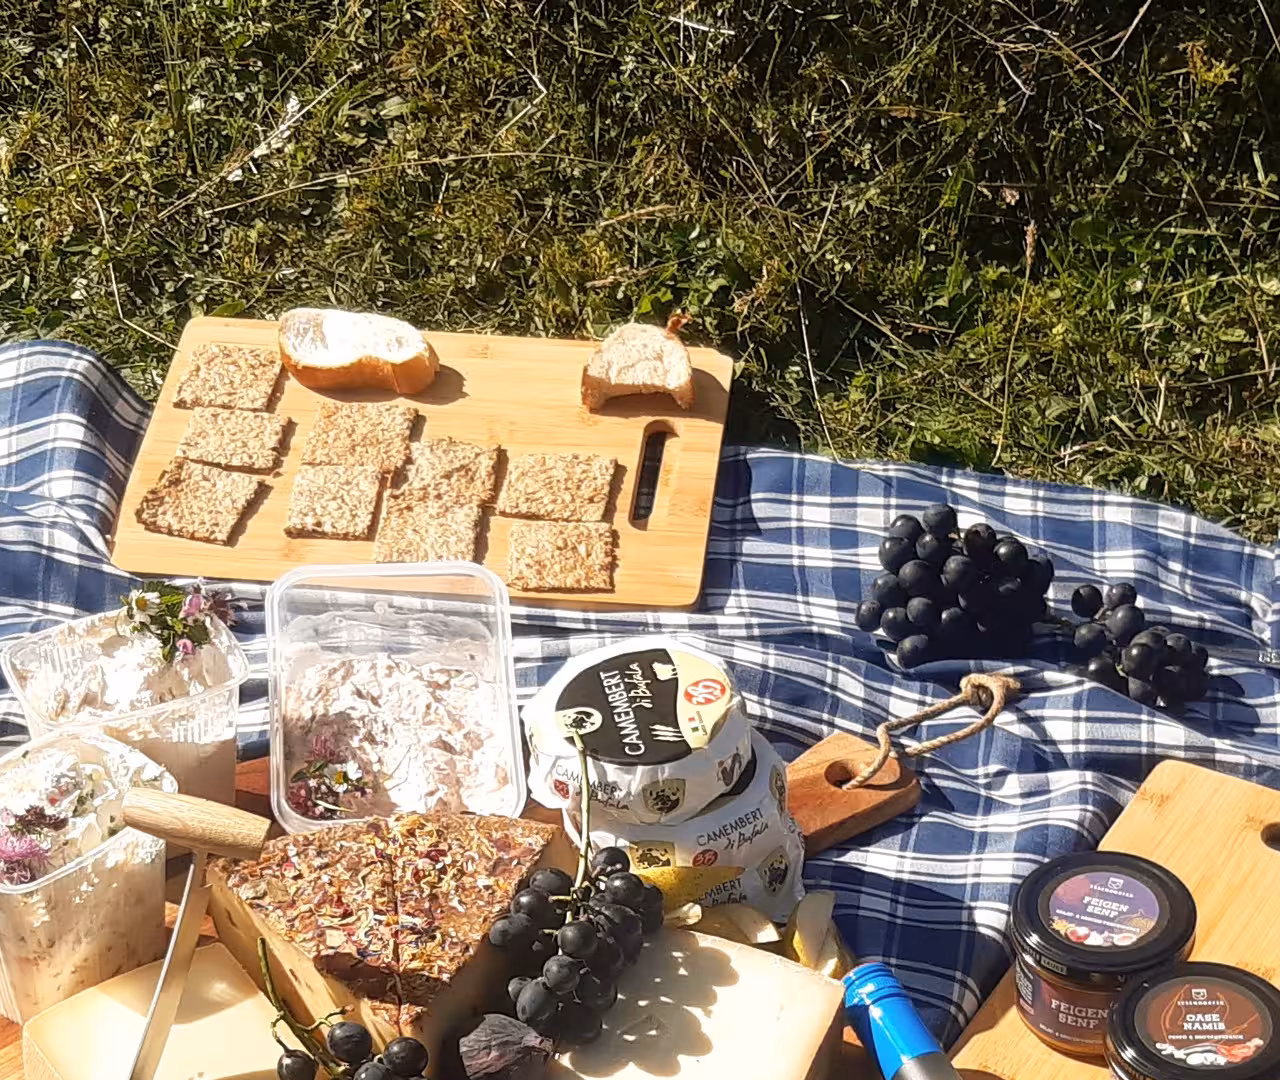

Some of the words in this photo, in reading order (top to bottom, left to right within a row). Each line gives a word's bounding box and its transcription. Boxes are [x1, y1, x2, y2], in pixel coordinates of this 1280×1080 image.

[624, 662, 653, 697] Bufala
[600, 670, 645, 756] CAMEMBERT
[696, 807, 763, 847] CAMEMBERT
[737, 822, 769, 850] Bufala
[1082, 895, 1129, 912] FEIGEN
[1086, 905, 1118, 918] SENF
[1051, 998, 1109, 1019] FEIGEN
[1186, 1013, 1220, 1022] OASE
[1058, 1012, 1099, 1029] SENF
[1183, 1022, 1226, 1030] NAMIB
